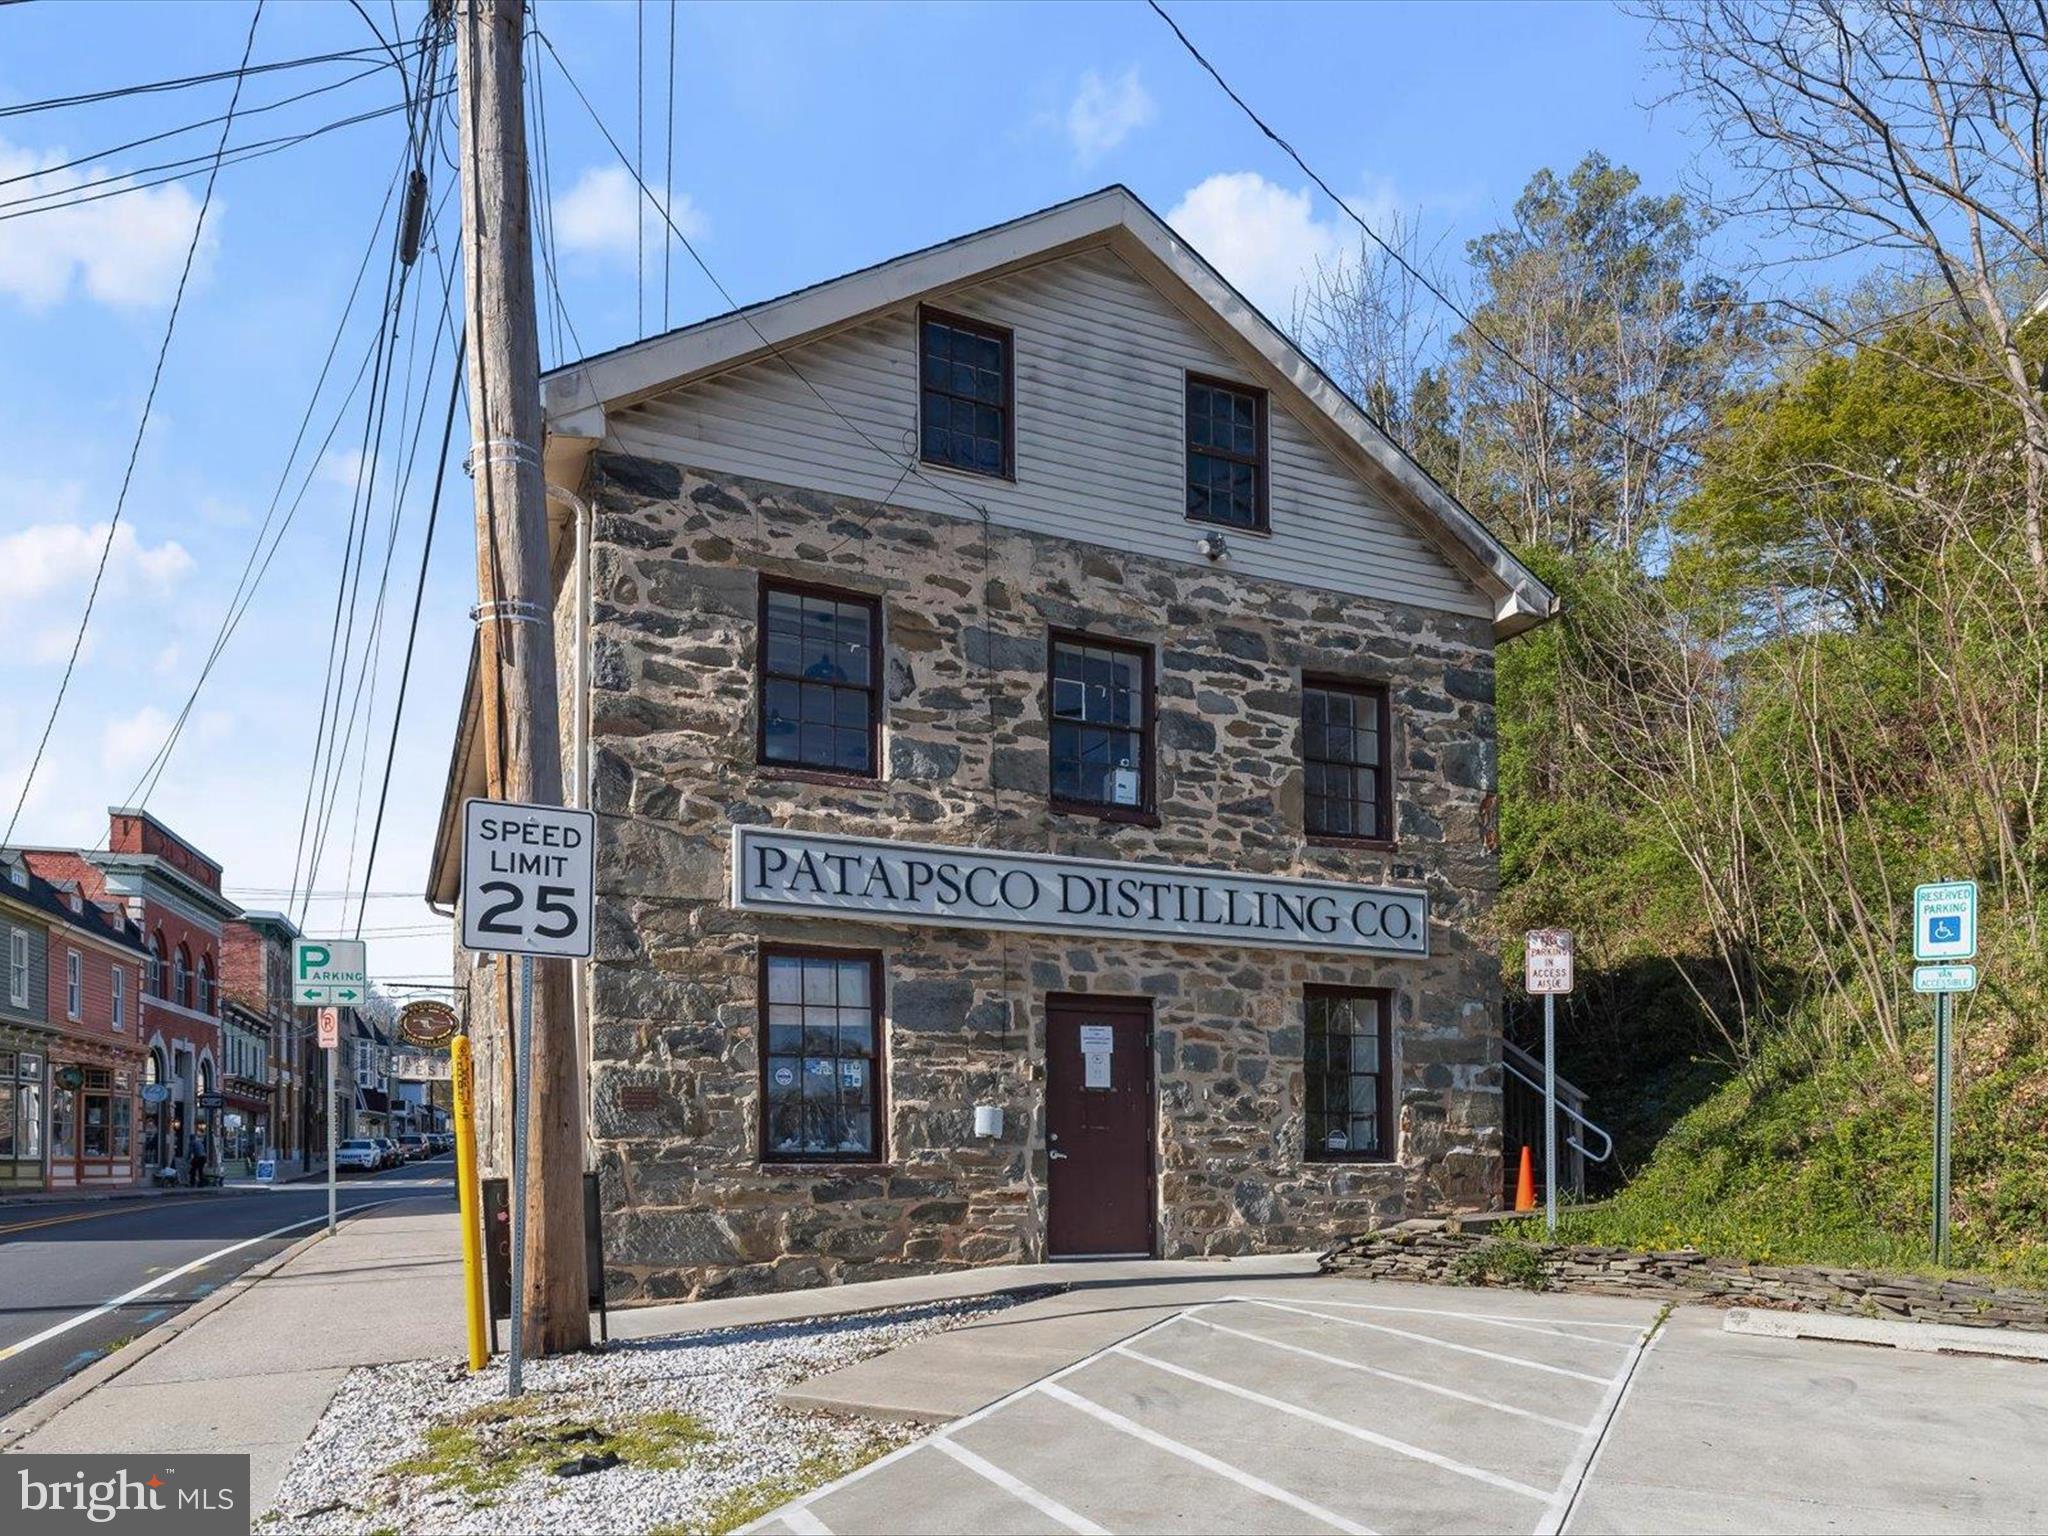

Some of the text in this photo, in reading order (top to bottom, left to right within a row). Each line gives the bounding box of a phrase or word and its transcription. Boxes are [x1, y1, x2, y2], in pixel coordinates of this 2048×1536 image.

[480, 818, 582, 849] SPEED
[490, 850, 568, 878] LIMIT
[753, 845, 1418, 940] PATAPSCO DISTILLING CO.
[1920, 888, 1971, 902] RESERVED
[477, 880, 579, 939] 25
[1923, 902, 1967, 914] PARKING
[299, 945, 363, 981] PARKING
[1532, 968, 1567, 978] ACCESS
[1544, 959, 1554, 967] IN
